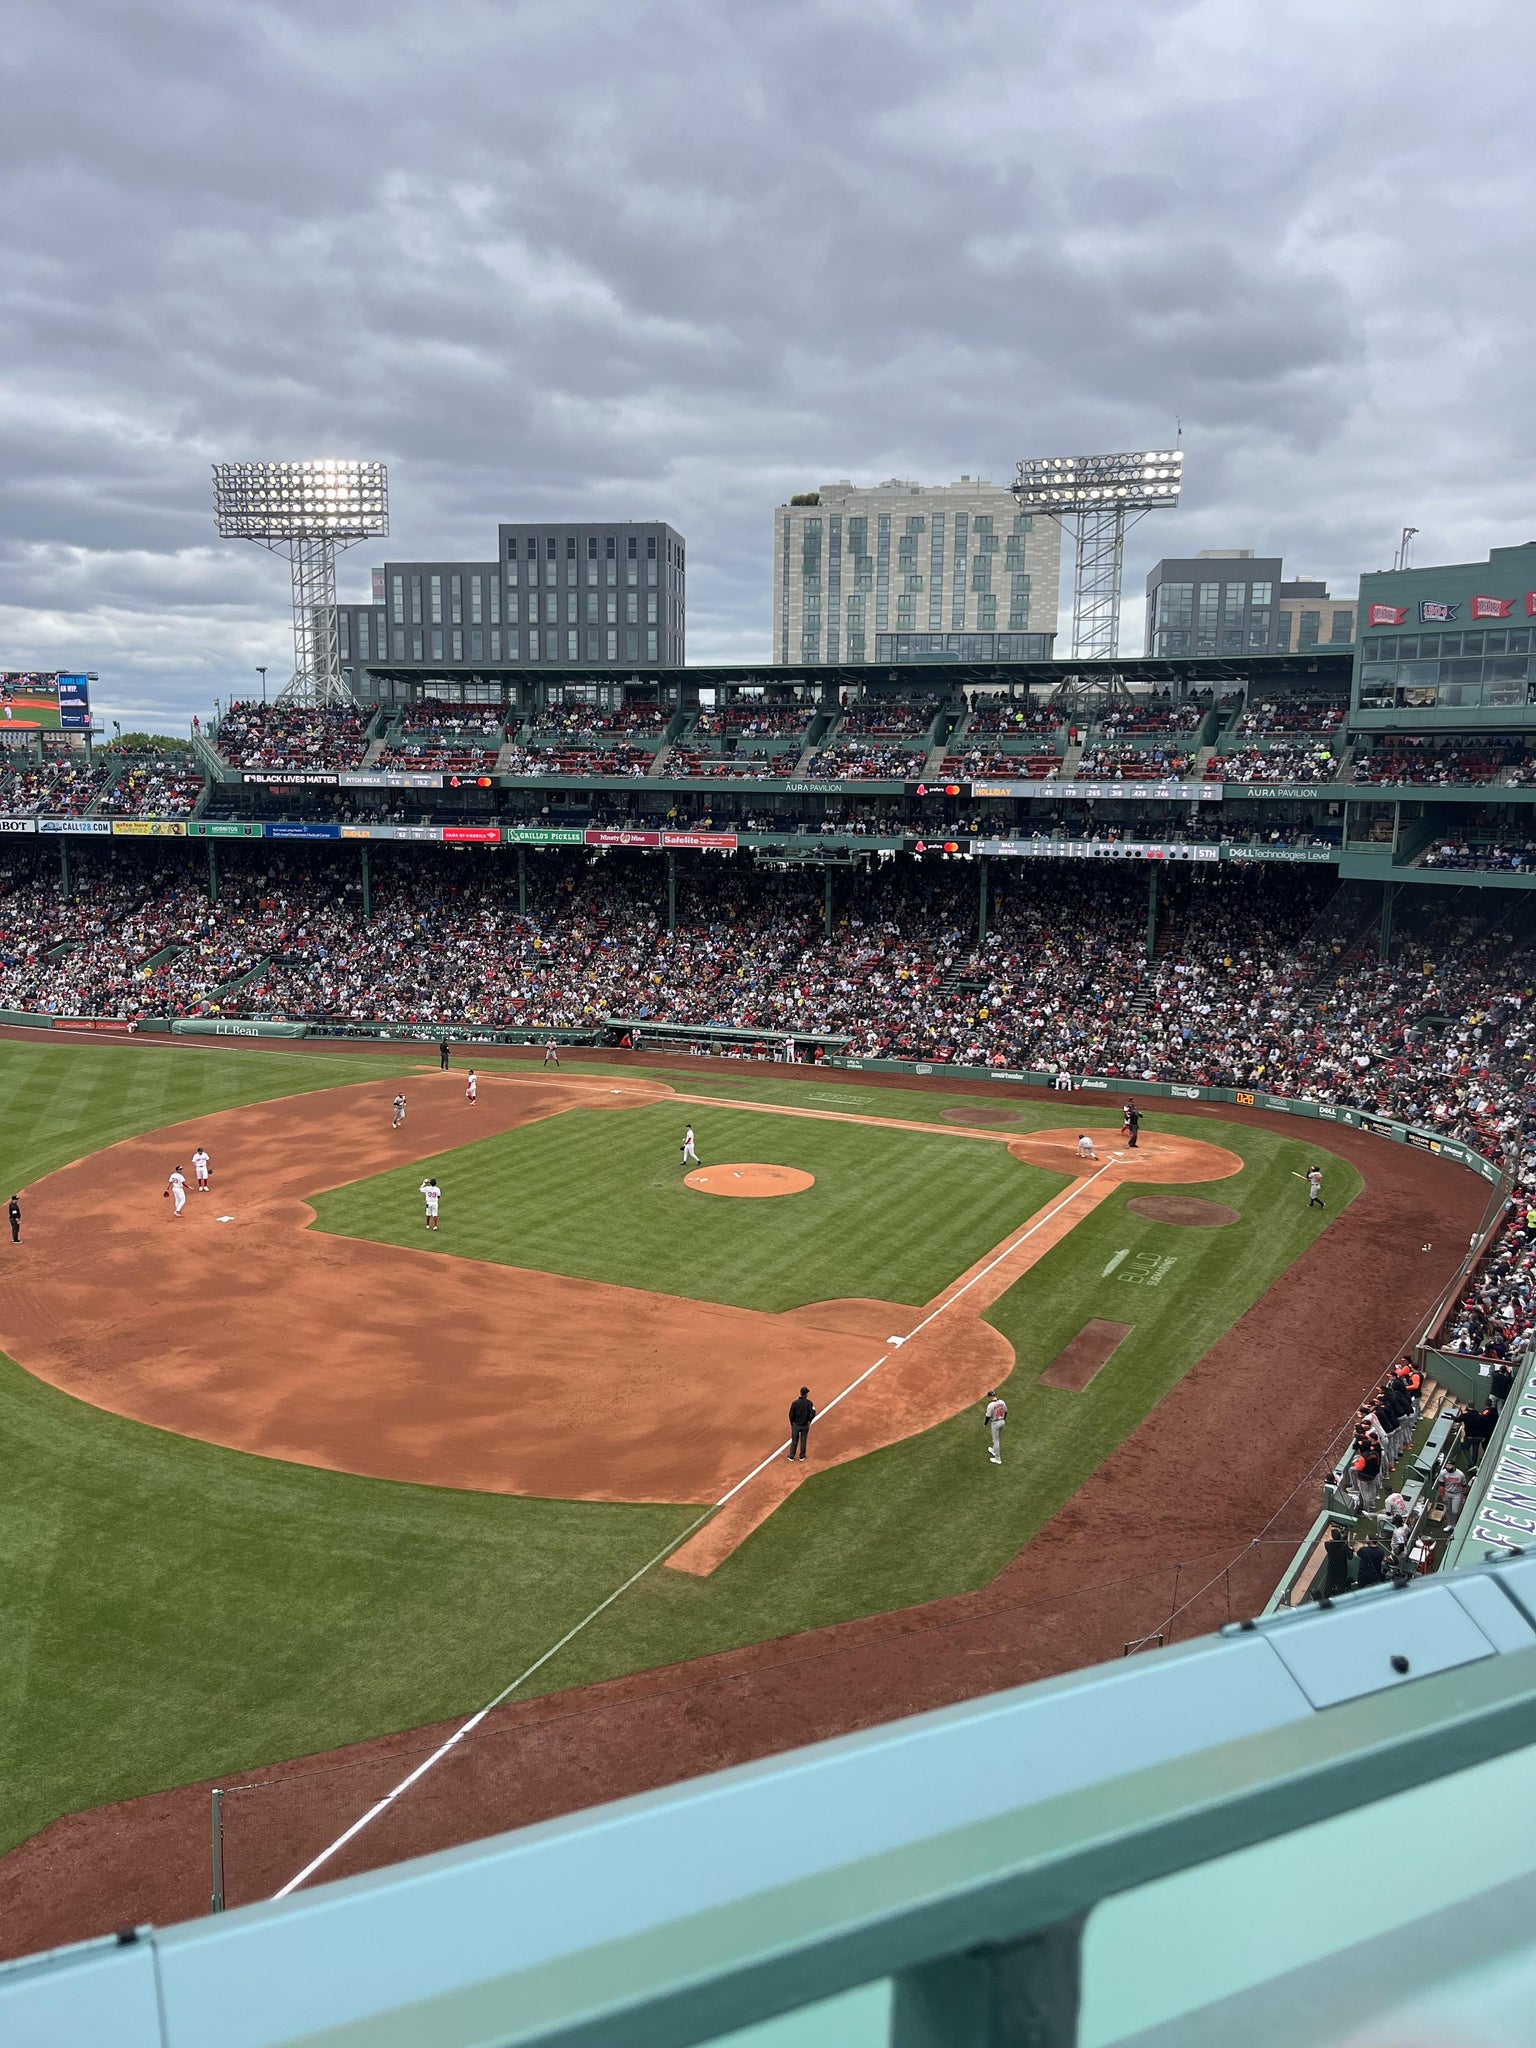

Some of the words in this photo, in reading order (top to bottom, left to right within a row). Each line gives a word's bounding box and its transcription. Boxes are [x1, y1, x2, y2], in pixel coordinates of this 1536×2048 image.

[256, 775, 283, 783] BLACK
[284, 776, 306, 784] LIVES
[306, 776, 337, 784] MATTER
[976, 788, 1011, 796] HOLLIDAY
[0, 822, 27, 831] BOT
[62, 822, 108, 833] CALL128.COM
[664, 836, 699, 844] Safelite
[1230, 849, 1254, 857] DELL
[1255, 849, 1306, 860] Technologies
[1308, 851, 1330, 860] Level
[216, 1025, 259, 1036] L.L.Bean
[1319, 1107, 1337, 1115] DELL
[1117, 1252, 1161, 1283] BUILD
